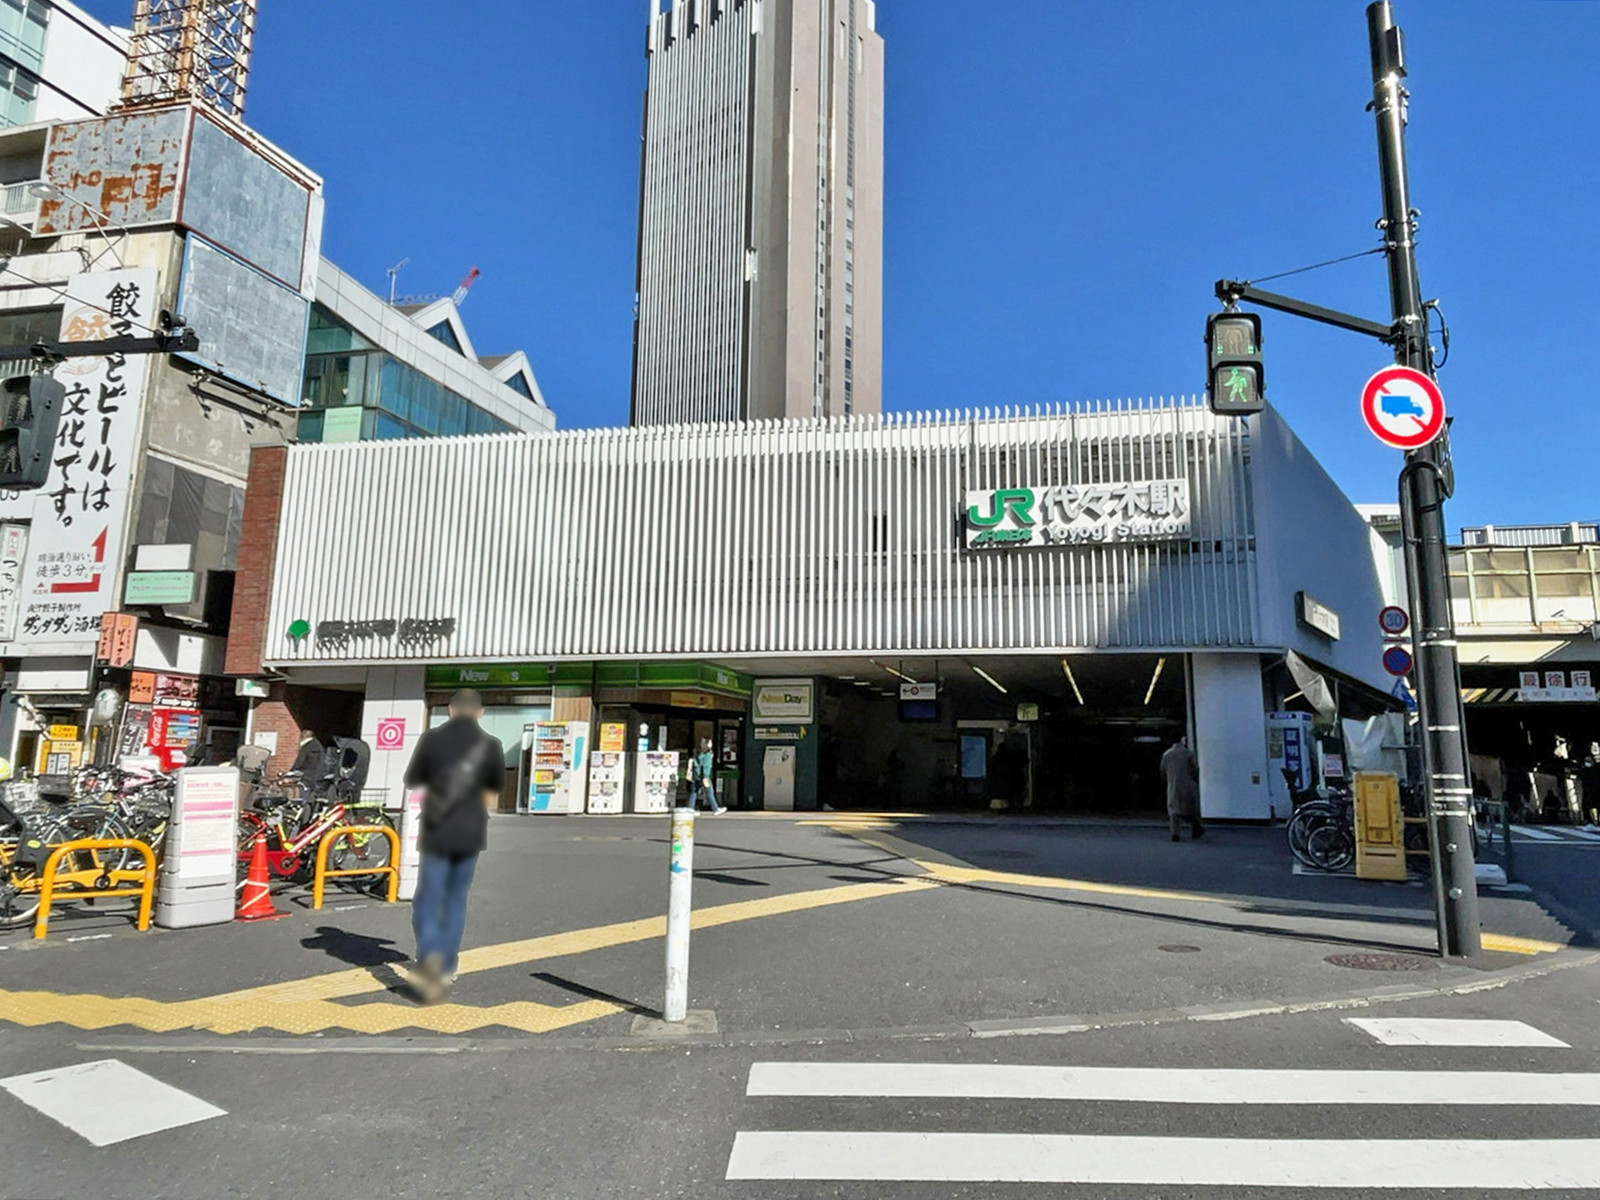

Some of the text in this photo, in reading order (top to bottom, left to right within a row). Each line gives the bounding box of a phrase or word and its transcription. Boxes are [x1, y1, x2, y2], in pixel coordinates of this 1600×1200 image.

[49, 382, 91, 527] 文化です。
[968, 488, 1036, 526] JR
[1045, 480, 1188, 521] 代々木駅
[1046, 518, 1190, 543] Yoyogi Station
[1386, 612, 1402, 628] 30
